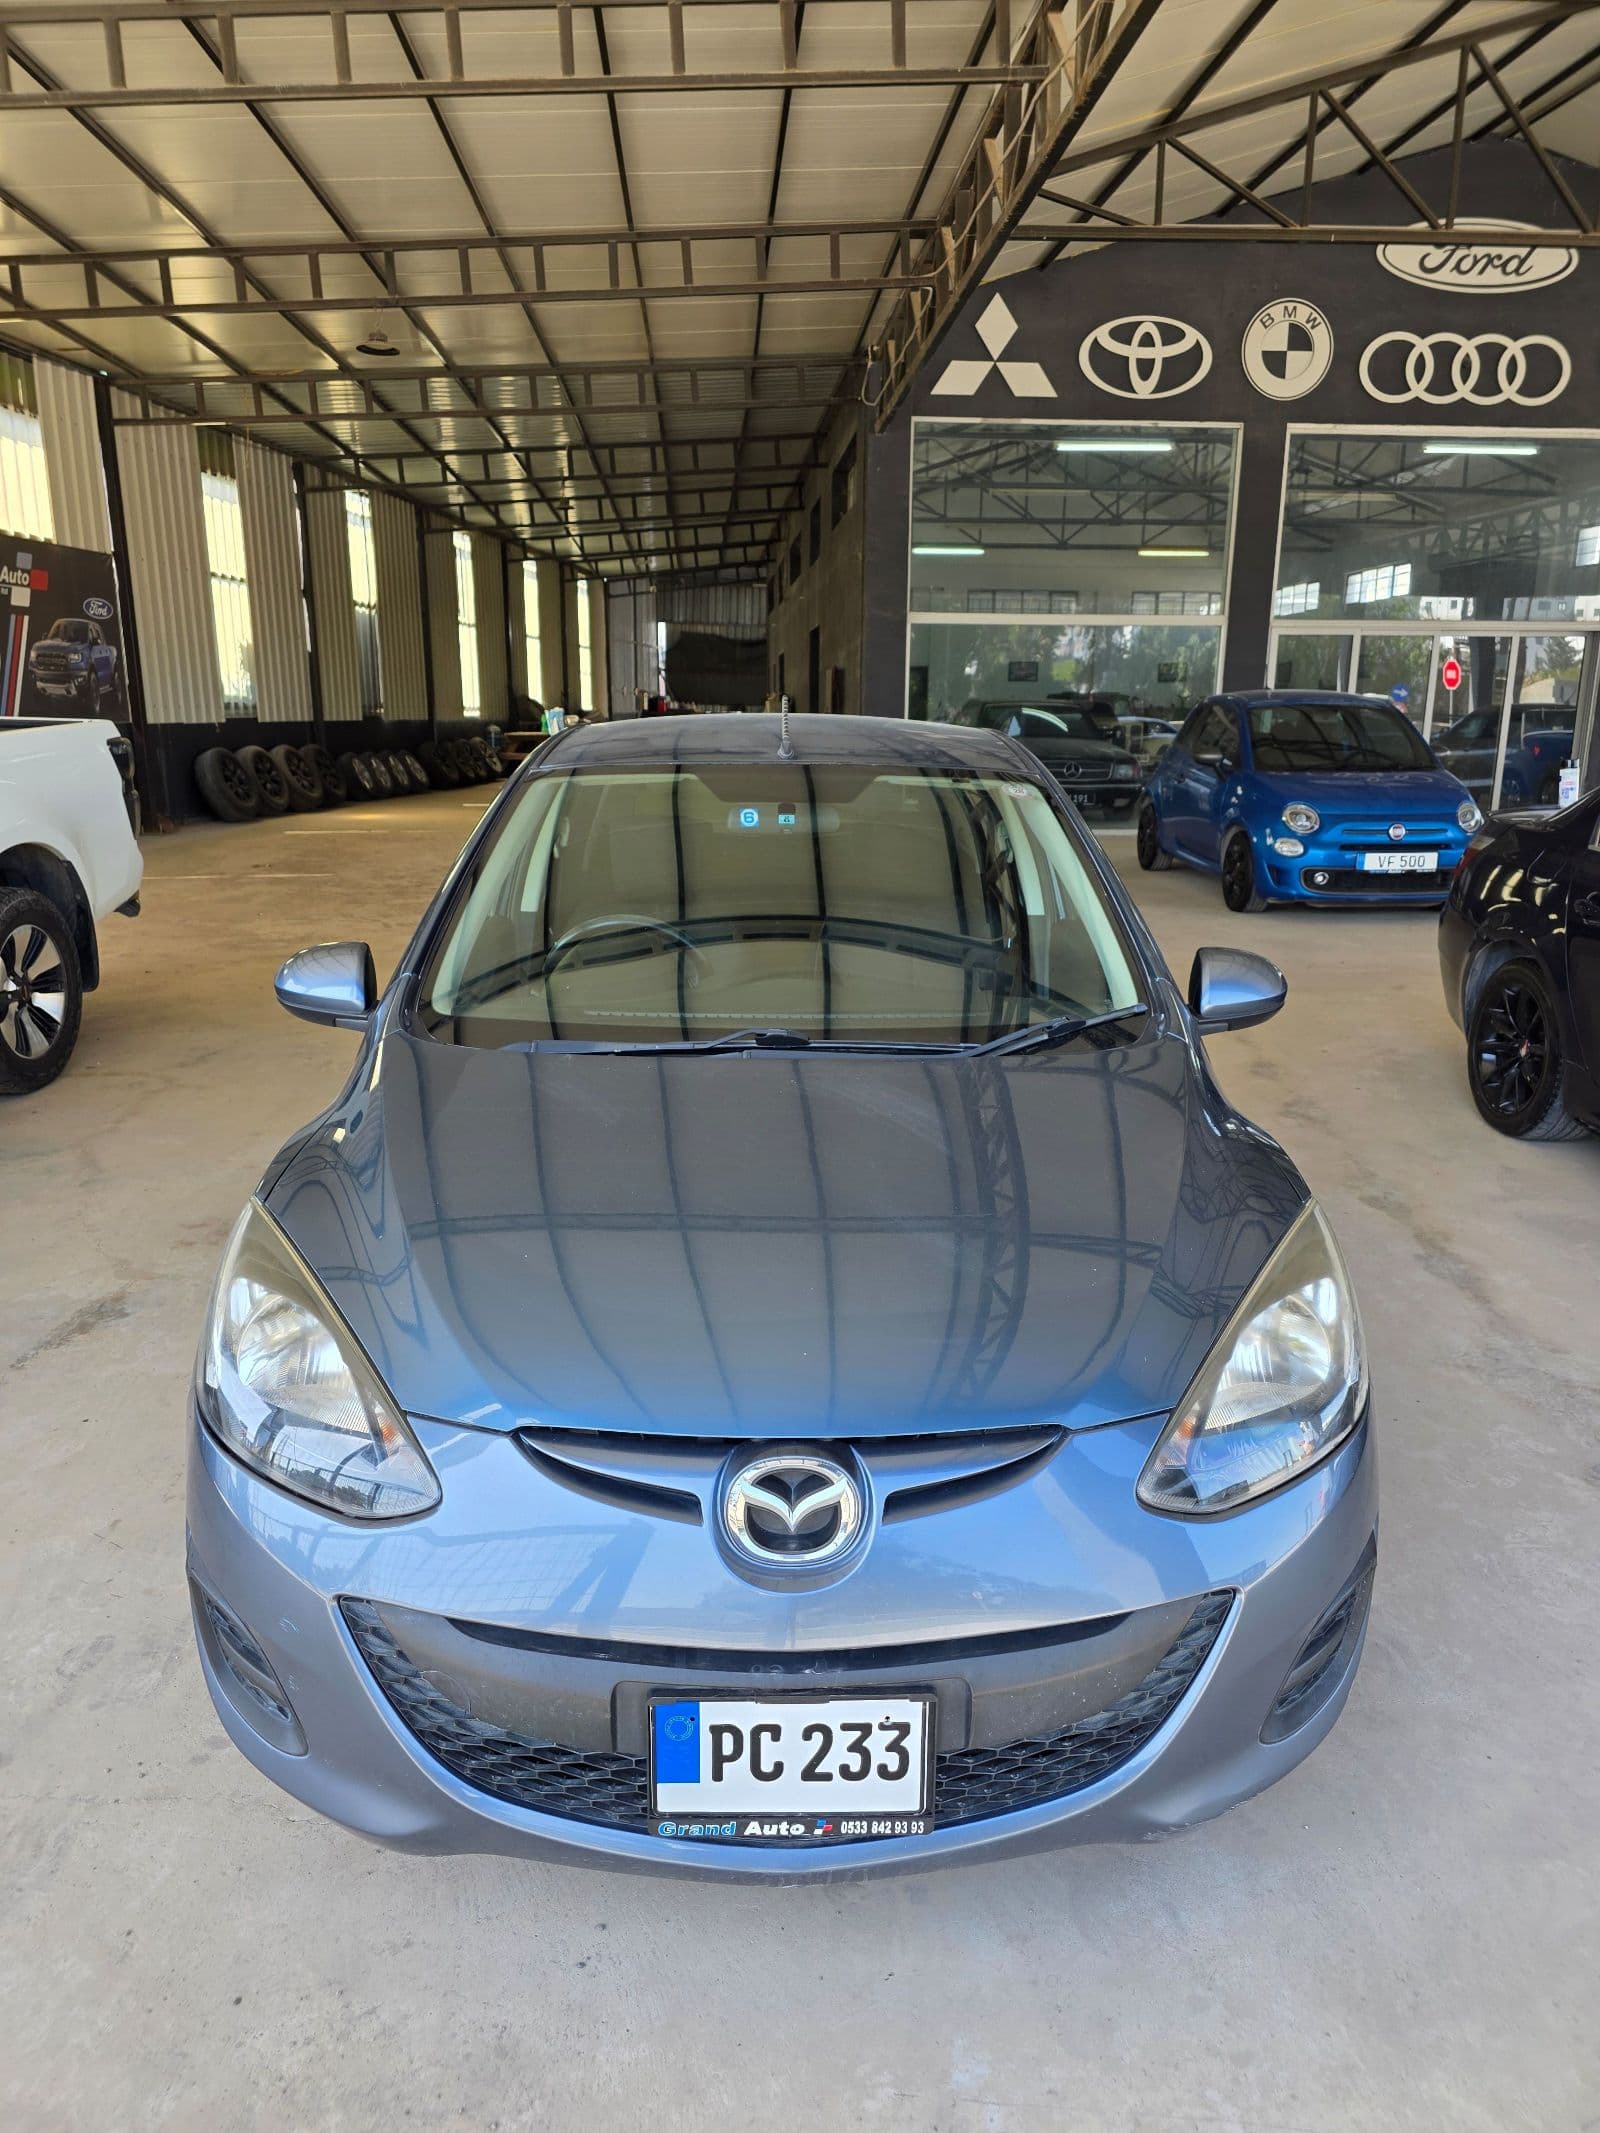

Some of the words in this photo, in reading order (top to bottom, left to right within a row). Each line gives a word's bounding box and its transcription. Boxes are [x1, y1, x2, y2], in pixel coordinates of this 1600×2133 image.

[1419, 244, 1533, 277] Ford
[1259, 305, 1322, 330] BMW
[0, 564, 30, 586] Auto
[1378, 855, 1397, 868] VF
[1399, 855, 1426, 868] 500
[708, 1723, 784, 1782] PC
[800, 1722, 911, 1782] 233
[658, 1821, 736, 1836] Grand
[743, 1821, 805, 1836] Auto
[840, 1820, 868, 1834] 0533
[871, 1820, 892, 1834] 842
[894, 1821, 908, 1834] 93
[910, 1821, 925, 1834] 93
